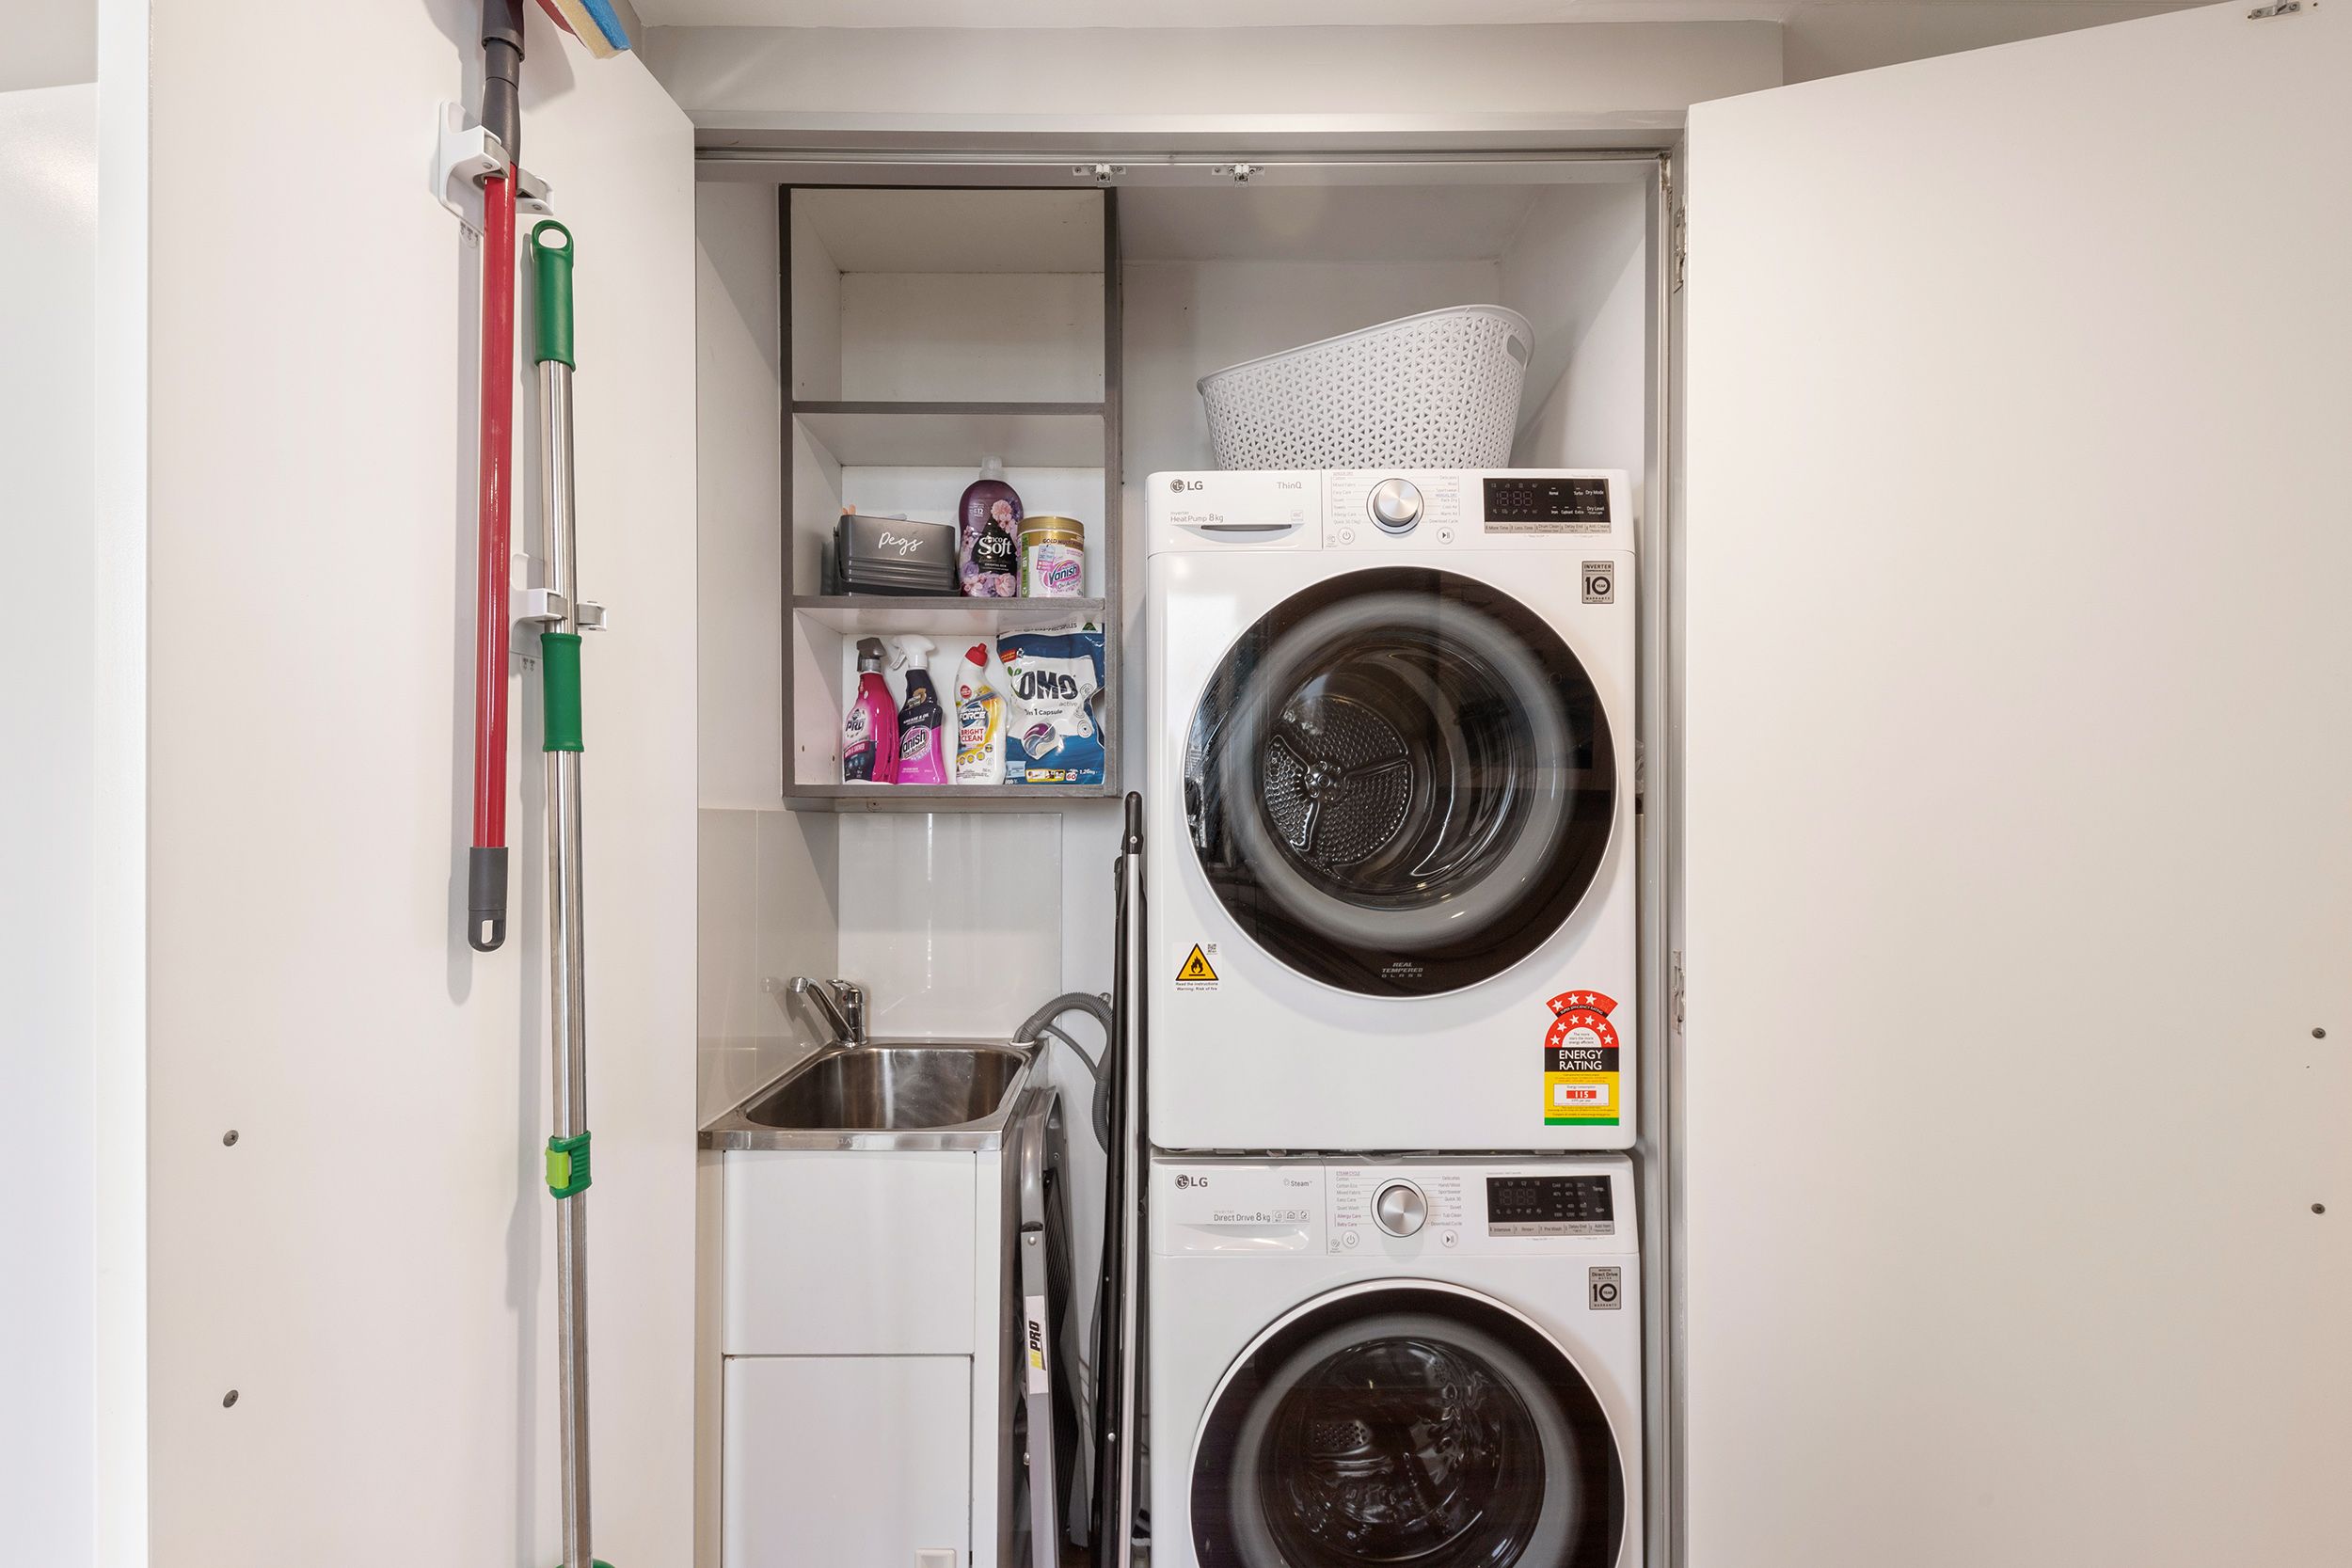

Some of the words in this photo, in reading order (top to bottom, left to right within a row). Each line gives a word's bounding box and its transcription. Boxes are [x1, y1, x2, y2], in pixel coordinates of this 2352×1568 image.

[1187, 481, 1203, 491] LG
[878, 532, 923, 555] Pegs
[978, 537, 1012, 557] Soft
[1049, 564, 1077, 585] Vanish
[1585, 576, 1611, 595] 10
[1019, 670, 1078, 700] OMO
[960, 711, 986, 721] FORCE
[1590, 1006, 1604, 1014] RATING
[1559, 1050, 1603, 1059] ENERGY
[1559, 1061, 1602, 1070] RATING
[1191, 1177, 1208, 1187] LG
[1593, 1283, 1617, 1302] 10
